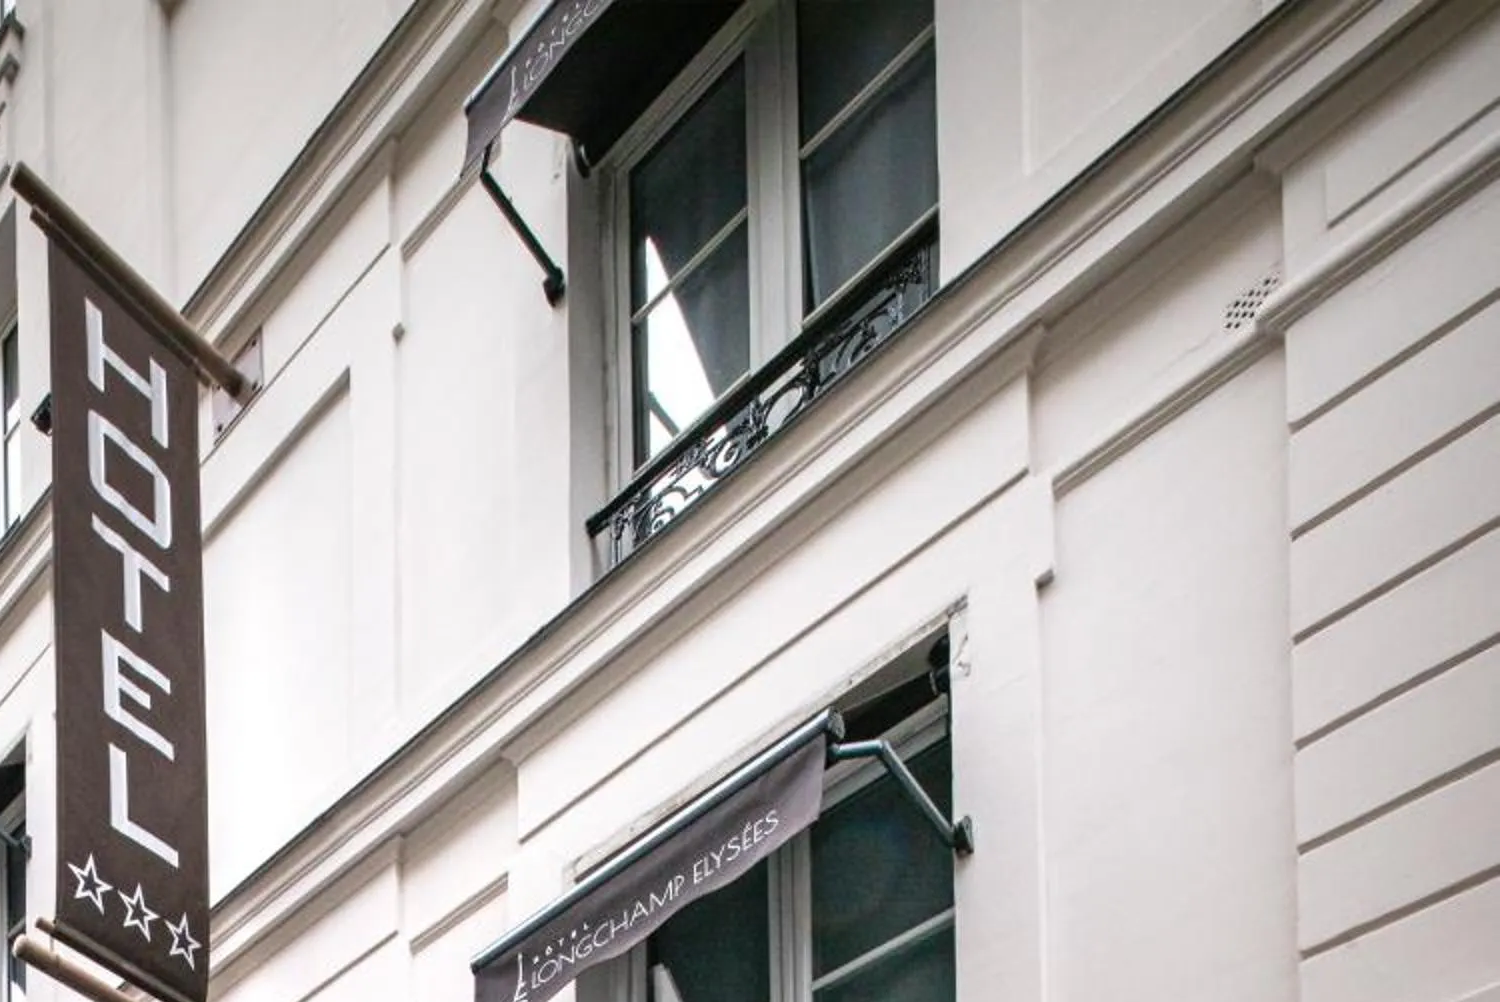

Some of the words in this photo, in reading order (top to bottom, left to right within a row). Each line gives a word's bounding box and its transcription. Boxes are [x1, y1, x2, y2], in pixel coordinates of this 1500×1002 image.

[84, 296, 180, 868] HOTEL
[531, 874, 685, 989] LONGCHAMP
[693, 809, 780, 885] ELYSÉES
